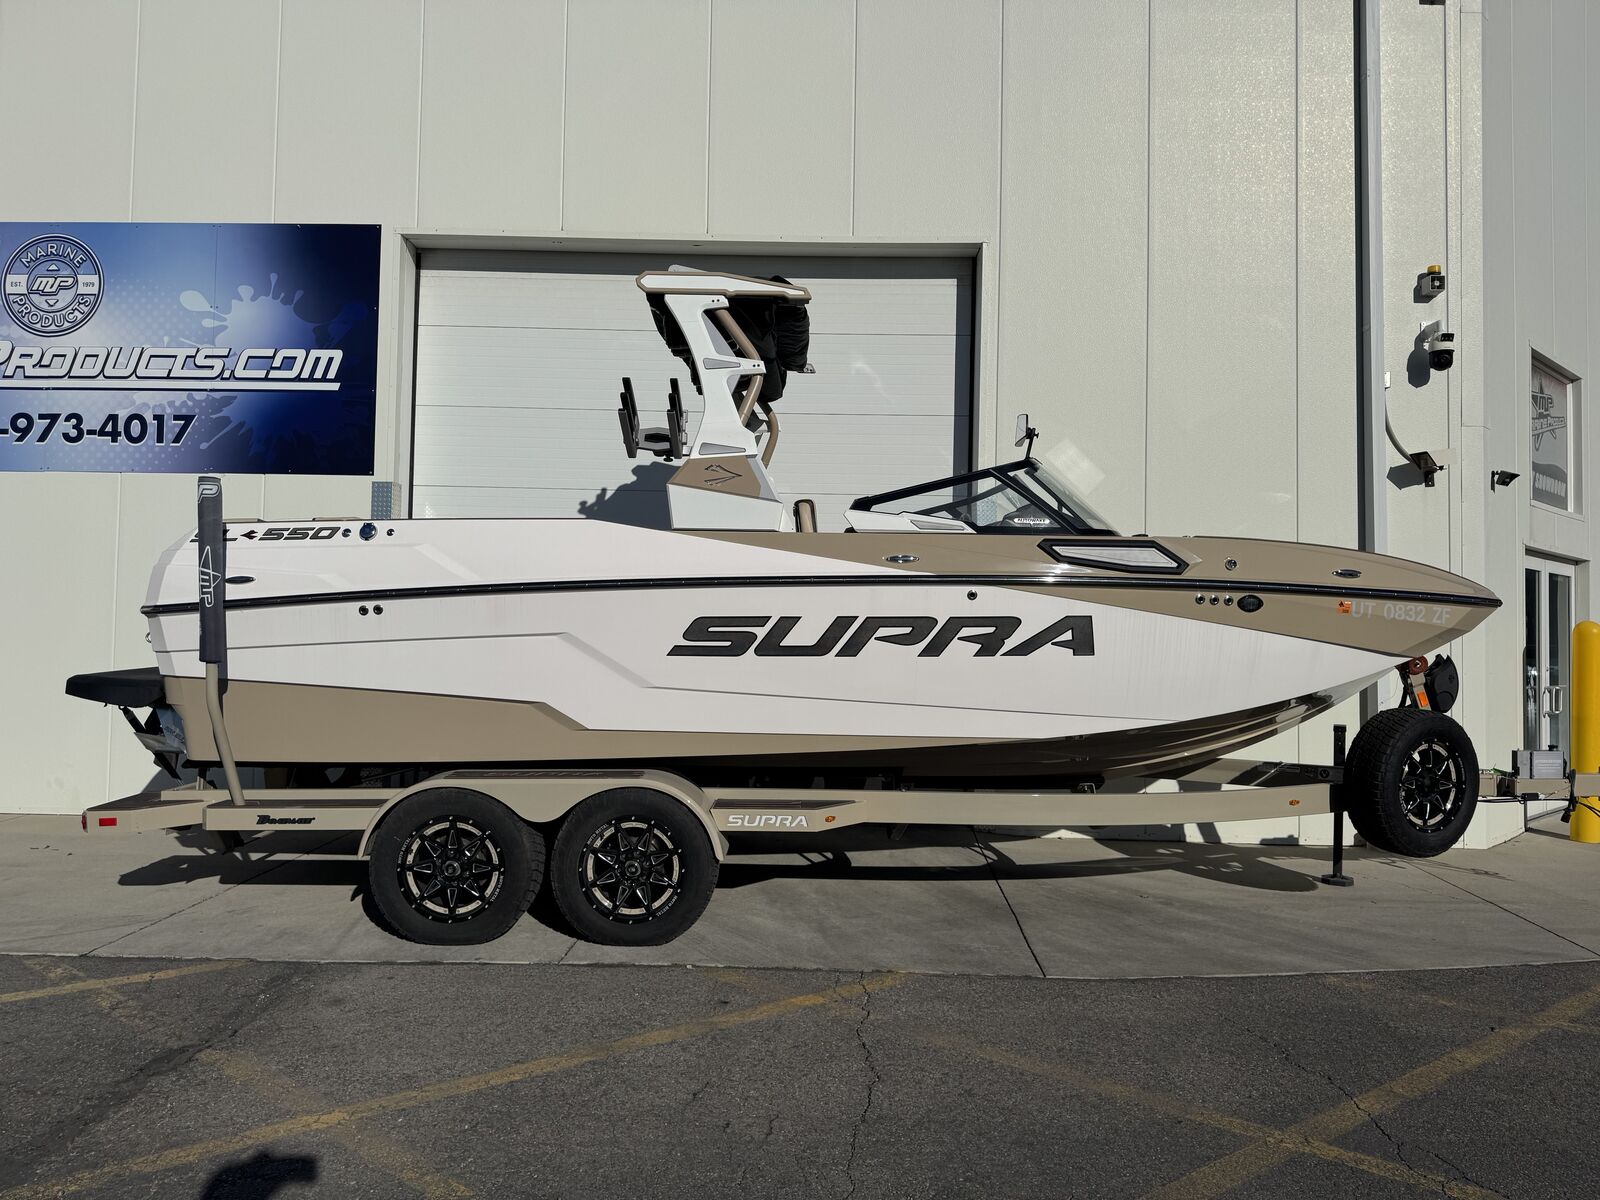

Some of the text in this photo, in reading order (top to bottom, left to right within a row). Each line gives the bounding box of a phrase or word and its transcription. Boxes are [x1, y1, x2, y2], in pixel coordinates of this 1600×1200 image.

[21, 243, 87, 268] MARINE
[13, 295, 91, 328] PRODUCTS
[258, 527, 341, 541] 550
[1352, 600, 1451, 624] UT 0832 ZF
[666, 616, 1096, 657] SUPRA
[727, 815, 809, 828] SUPRA
